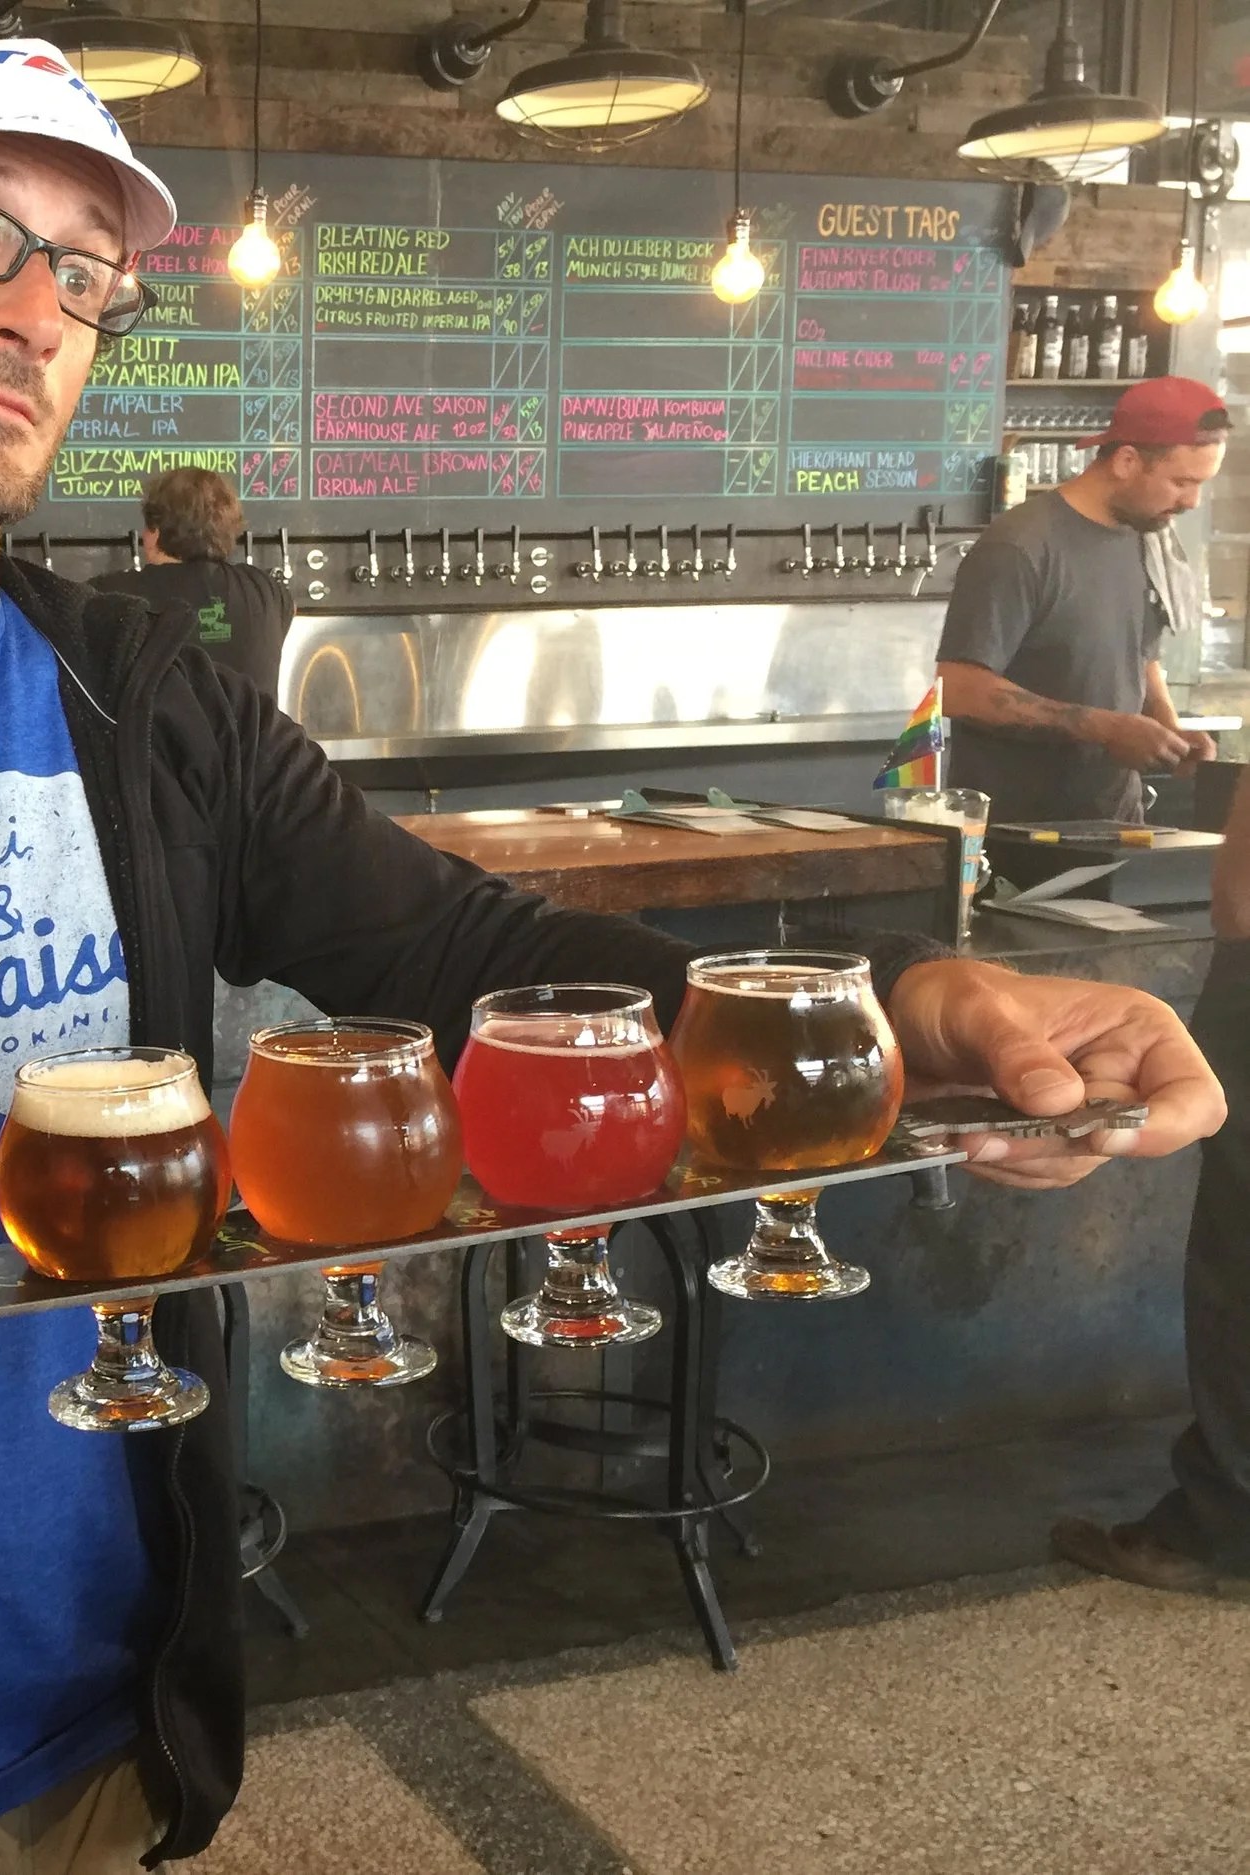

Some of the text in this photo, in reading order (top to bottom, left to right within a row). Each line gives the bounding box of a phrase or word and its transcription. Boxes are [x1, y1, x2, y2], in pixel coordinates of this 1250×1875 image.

[817, 202, 900, 240] GUEST
[903, 204, 961, 243] TAPS
[317, 225, 451, 251] BLEATING RED
[566, 237, 716, 259] ACH DU LIEBER BOCK
[147, 255, 184, 273] PEEL
[318, 249, 430, 276] IRISH RED ALE
[565, 259, 622, 279] MUNICH
[800, 247, 839, 269] FINN
[891, 247, 937, 269] CIDER
[391, 288, 444, 308] BARREL
[446, 289, 479, 305] AGED
[315, 306, 492, 330] CITRUS FRUITED IMPERIAL IPA
[121, 336, 179, 363] BUTT
[795, 350, 850, 368] INCLINE
[854, 350, 895, 369] CIDER
[213, 364, 241, 388] IPA
[102, 394, 184, 414] IMPALER
[314, 393, 488, 419] SECOND AVE SAISON
[663, 399, 726, 417] KOMBUCHA
[152, 418, 179, 436] IPA
[315, 419, 410, 442] FARMHOUSE
[413, 423, 442, 442] ALE
[562, 420, 635, 441] PINEAPPLE
[315, 452, 489, 476] OATMEAL BROWN
[876, 450, 916, 470] MEAD
[56, 476, 145, 497] JUICY IPA
[317, 476, 421, 497] BROWN ALE
[796, 469, 918, 494] PEACH SESSION
